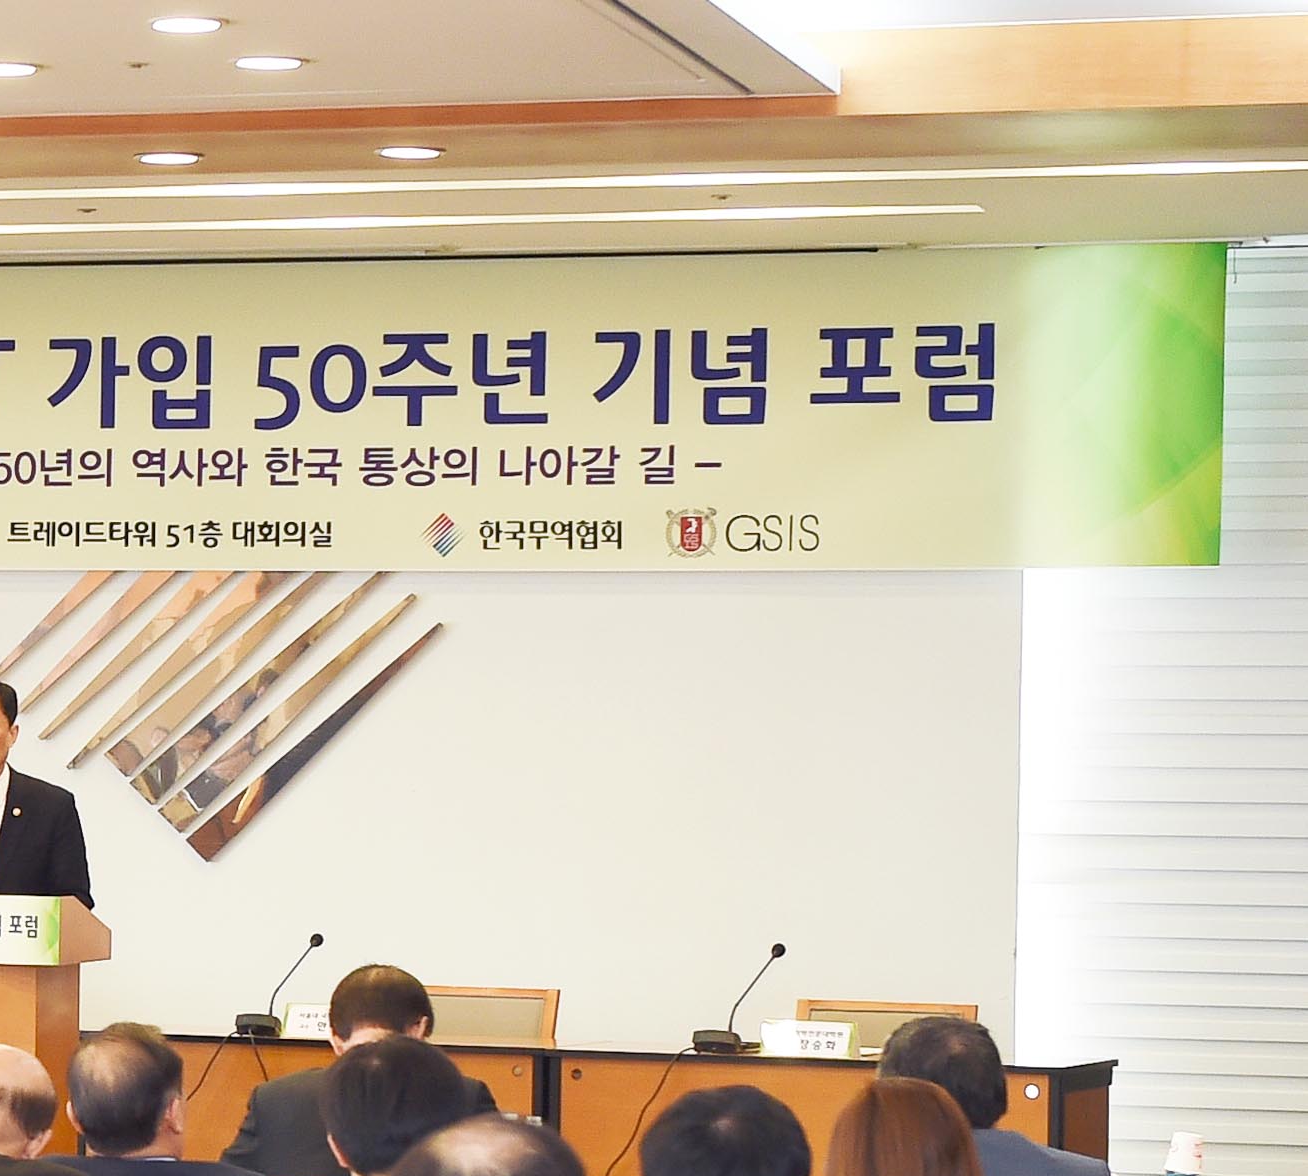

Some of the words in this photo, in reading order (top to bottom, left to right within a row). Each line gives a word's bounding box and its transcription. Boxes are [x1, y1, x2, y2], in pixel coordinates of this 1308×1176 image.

[46, 334, 212, 431] 가입
[252, 330, 550, 432] 50주년
[591, 327, 769, 426] 기념
[809, 322, 997, 423] 포럼
[132, 447, 249, 488] 역사와
[264, 447, 343, 487] 한국
[358, 446, 478, 487] 통상의
[499, 445, 621, 486] 나아갈
[638, 444, 675, 485] 길
[6, 521, 156, 548] 트레이드타워
[166, 520, 224, 549] 51층
[232, 520, 332, 548] 대회의실
[479, 519, 623, 550] 한국무역협회
[725, 514, 821, 553] GSIS
[8, 915, 39, 939] 포럼
